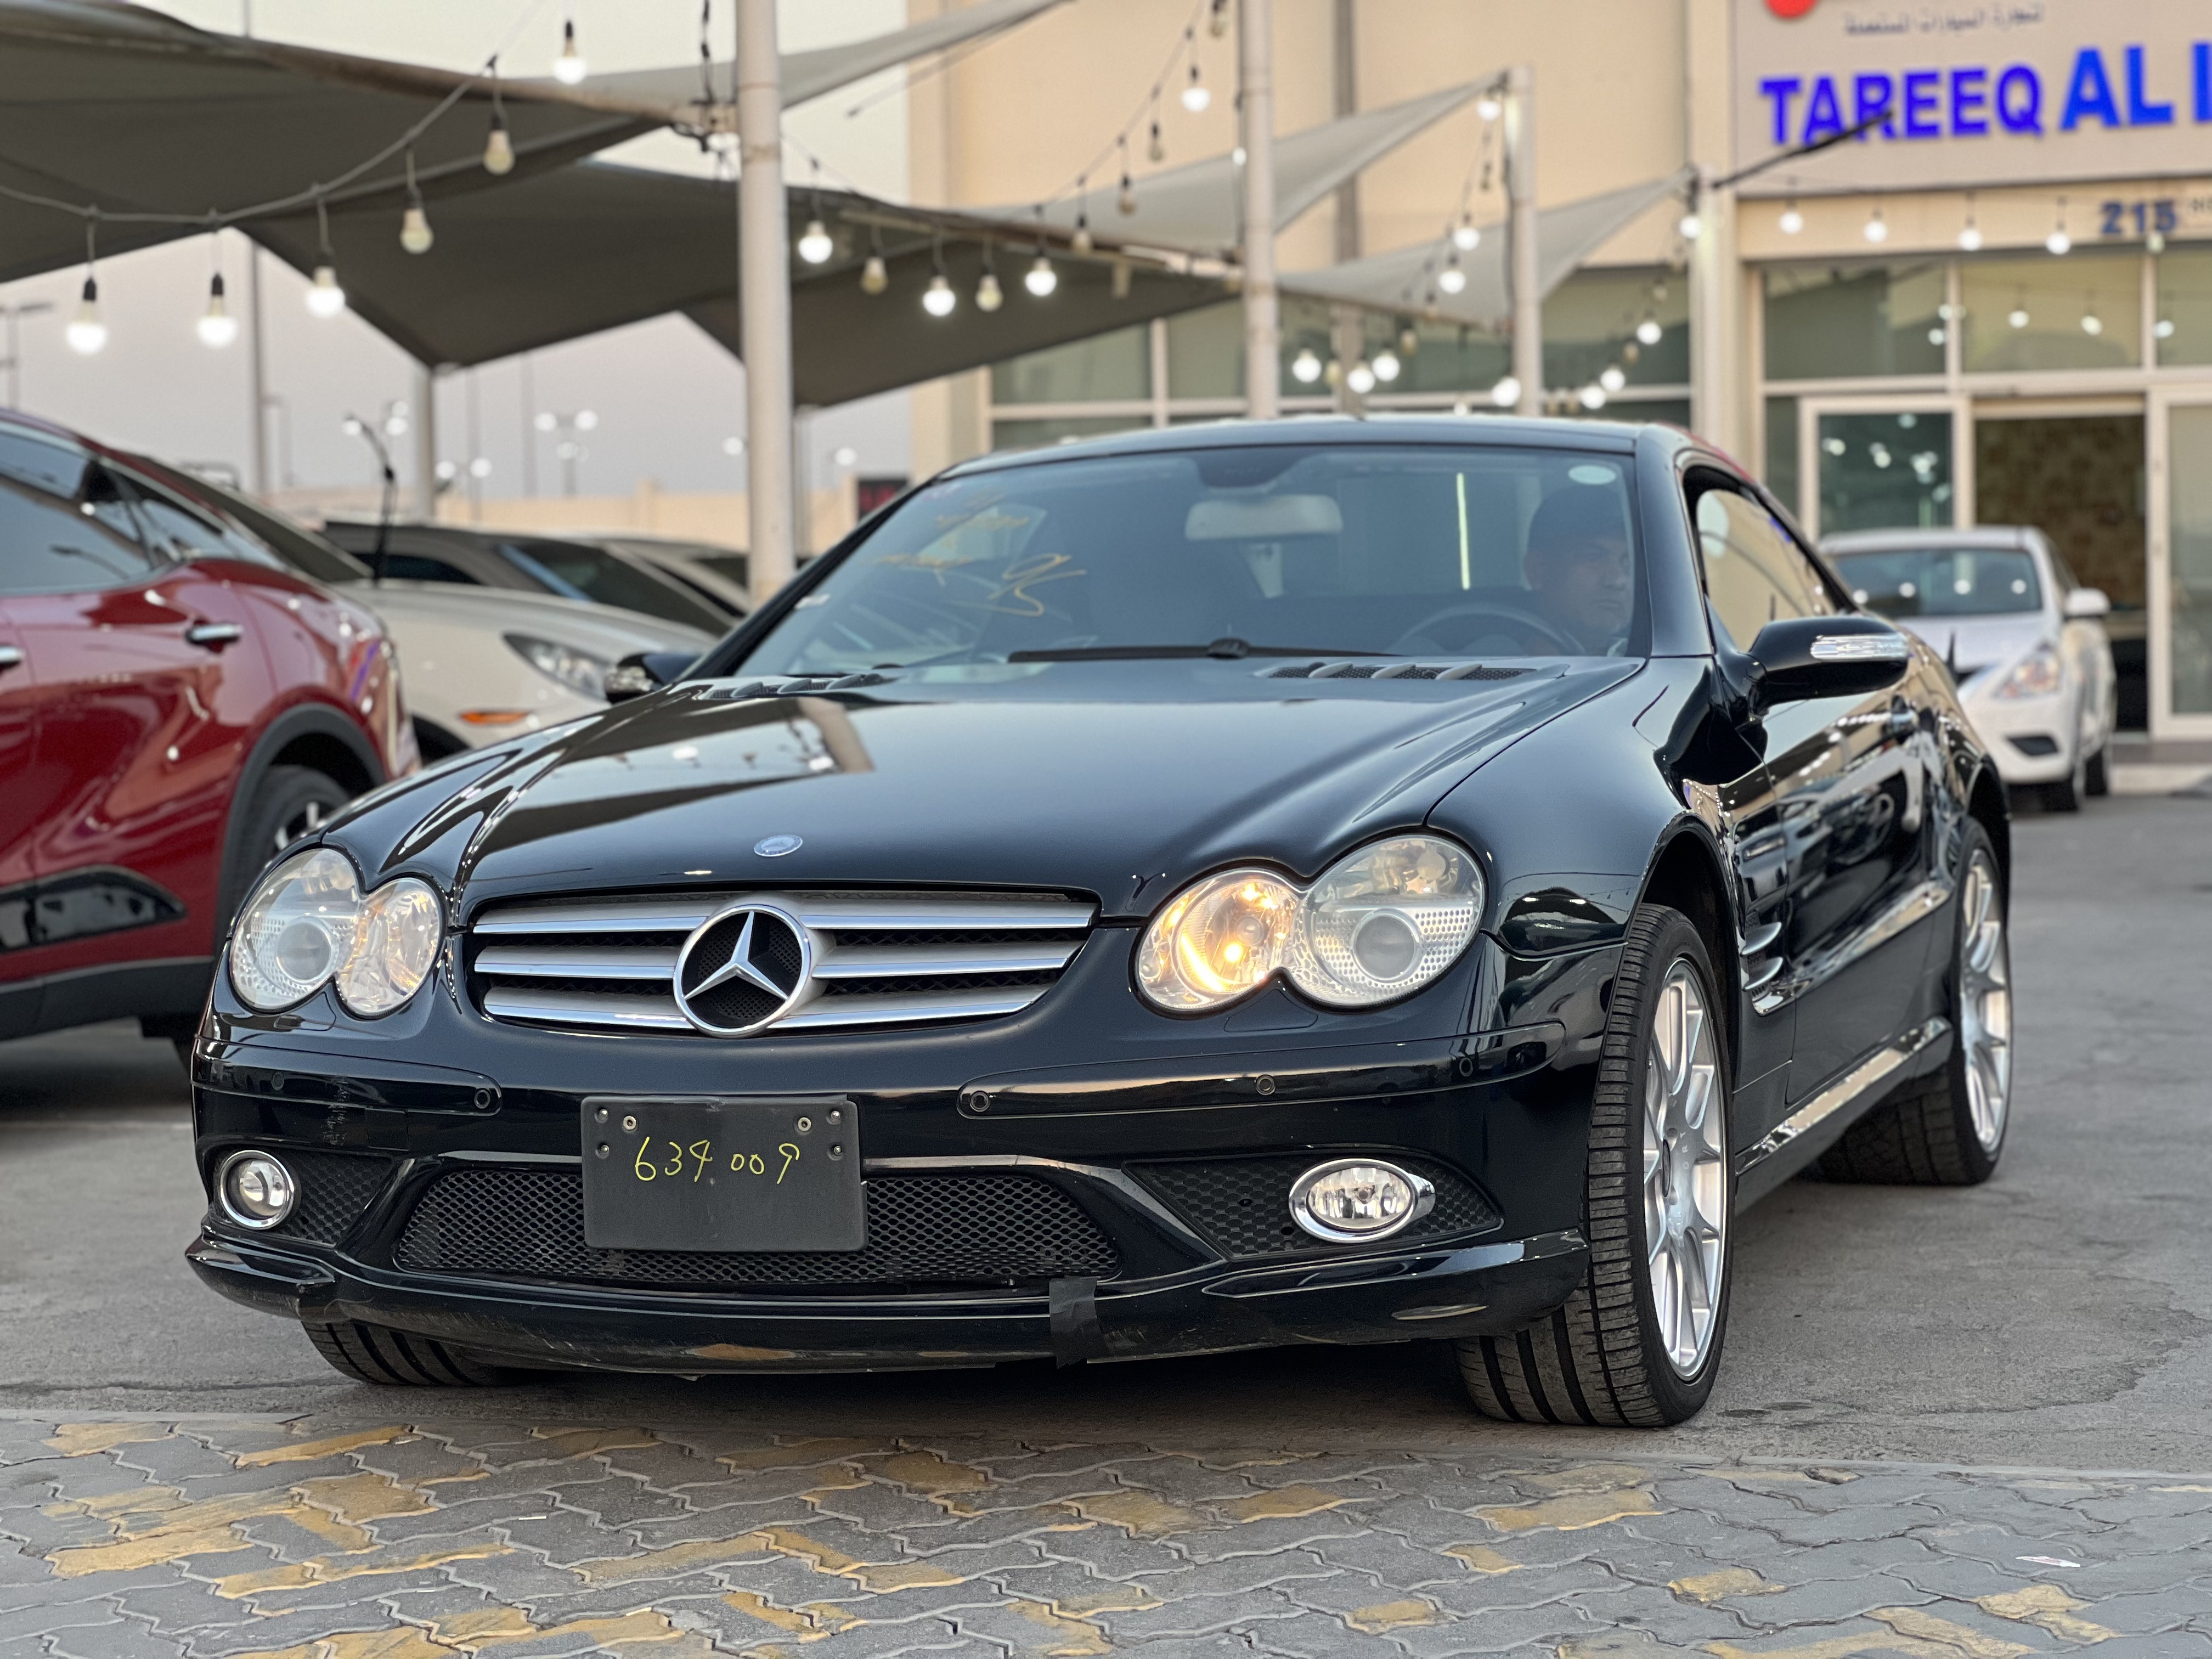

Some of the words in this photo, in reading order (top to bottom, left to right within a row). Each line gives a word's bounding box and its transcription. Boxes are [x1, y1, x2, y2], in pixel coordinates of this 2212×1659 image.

[1759, 64, 2044, 145] TAREEQ
[2059, 46, 2175, 130] AL
[2101, 199, 2177, 234] 215
[730, 1143, 800, 1184] 009
